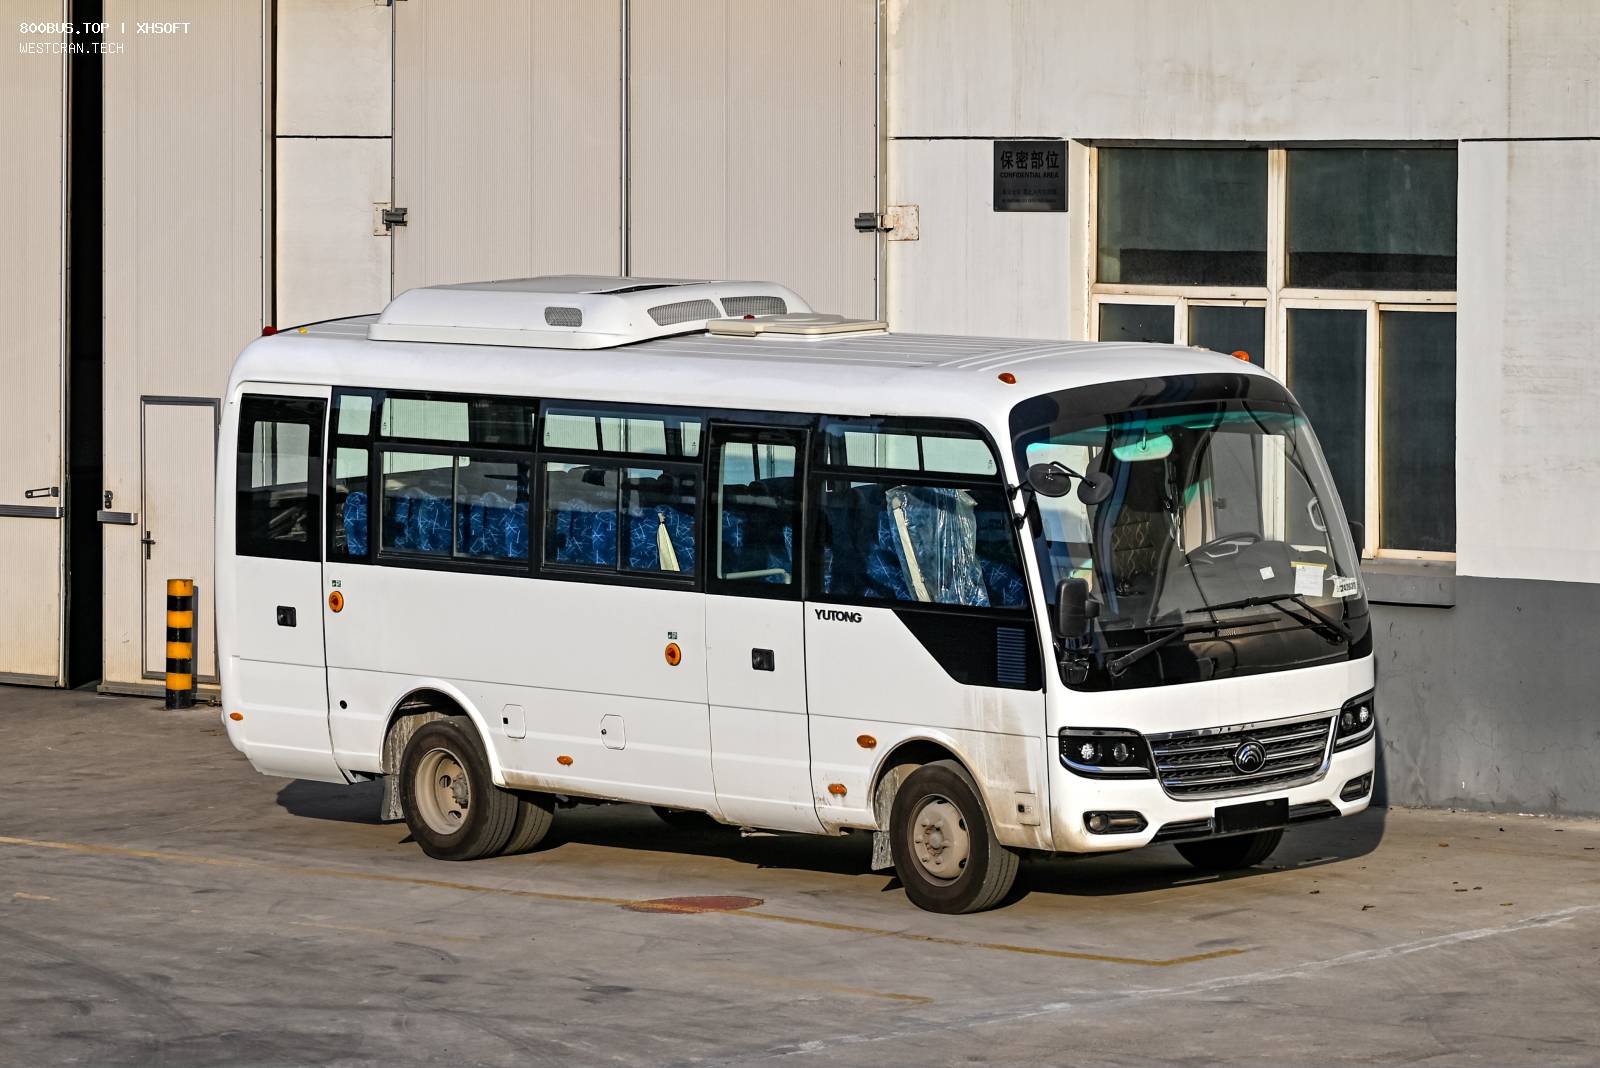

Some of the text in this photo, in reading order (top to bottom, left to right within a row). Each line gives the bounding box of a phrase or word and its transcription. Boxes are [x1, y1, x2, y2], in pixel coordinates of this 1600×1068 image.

[1000, 150, 1060, 170] 保密部位
[1000, 171, 1059, 179] CONFIDENTIAL AREA
[814, 608, 863, 624] YUTONG
